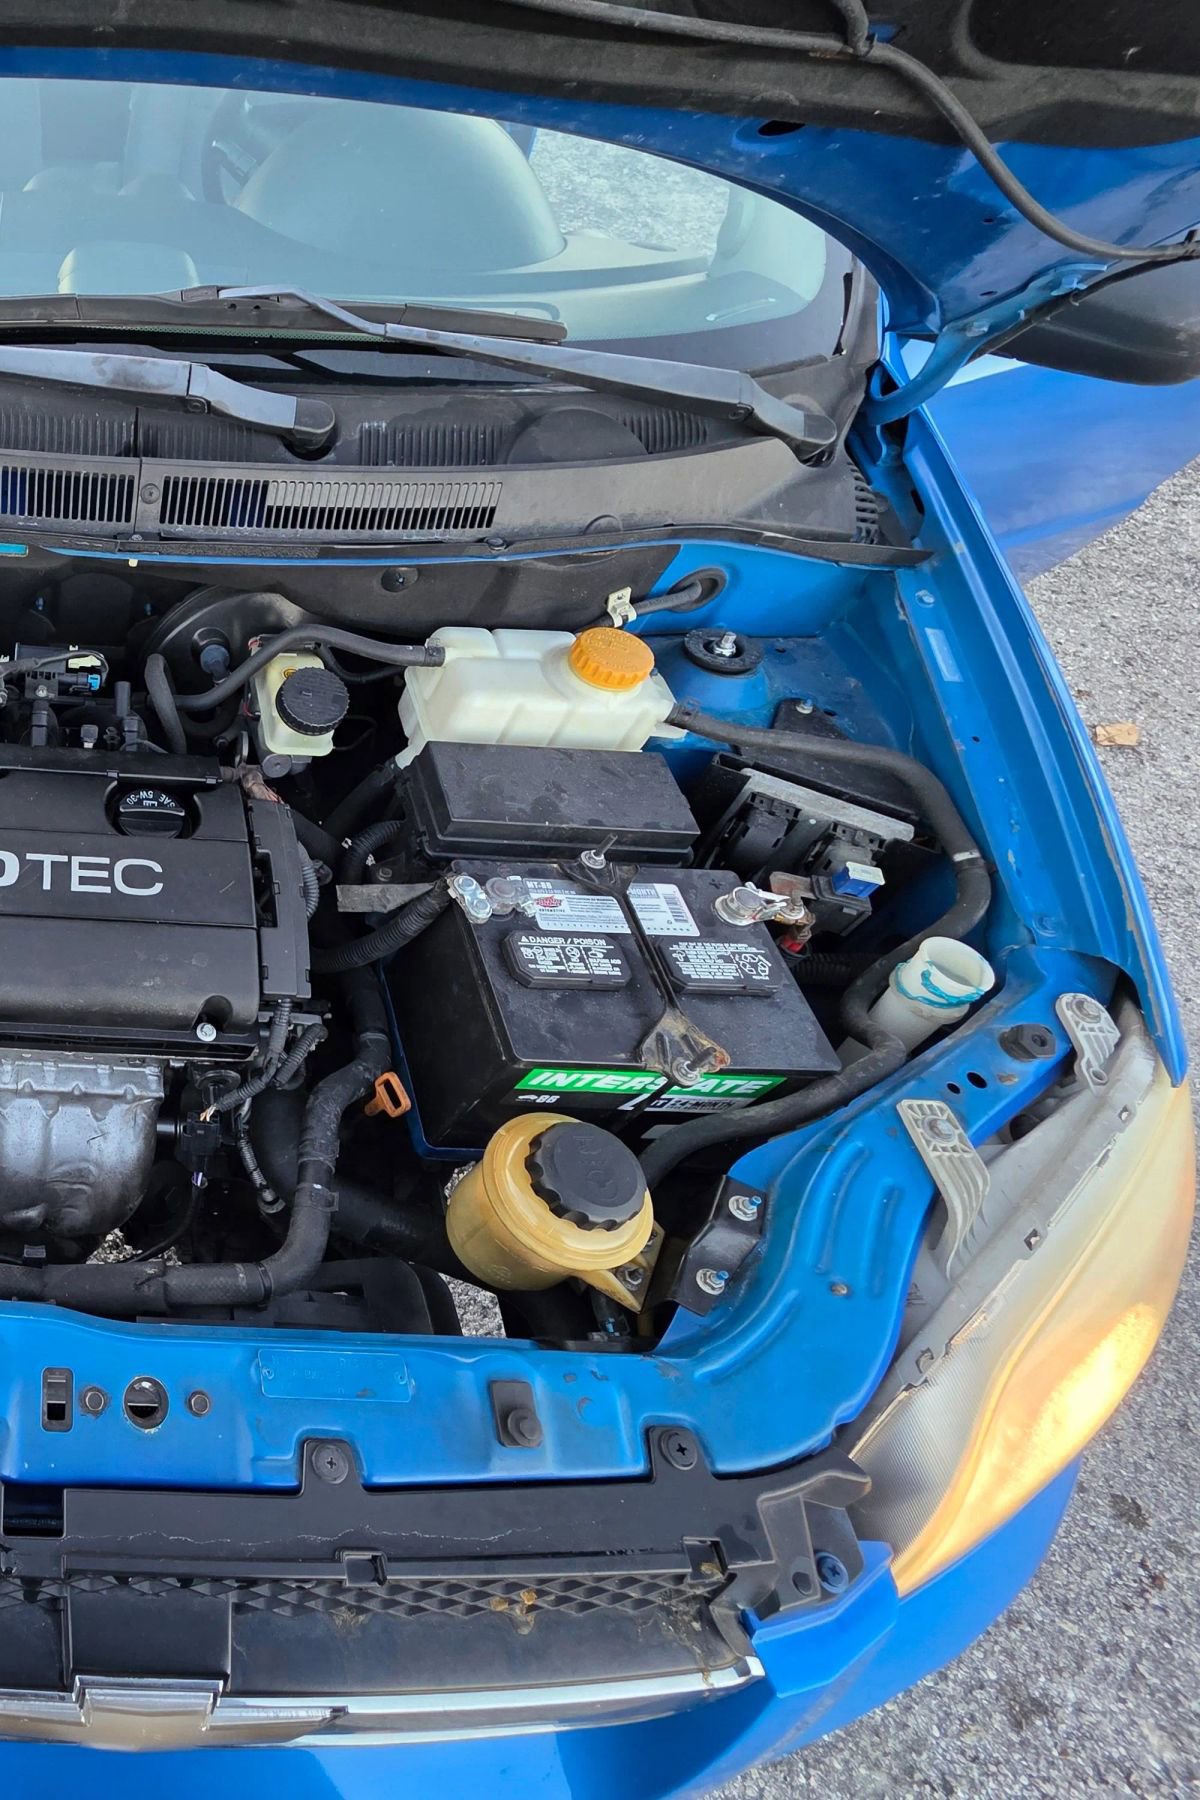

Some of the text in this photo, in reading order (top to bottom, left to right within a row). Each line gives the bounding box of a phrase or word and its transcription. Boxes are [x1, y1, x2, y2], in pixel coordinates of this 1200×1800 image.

[126, 790, 176, 808] SAE 5W-30
[529, 936, 565, 944] DANGER
[573, 937, 607, 946] POISON
[528, 1072, 773, 1094] INTERSATE
